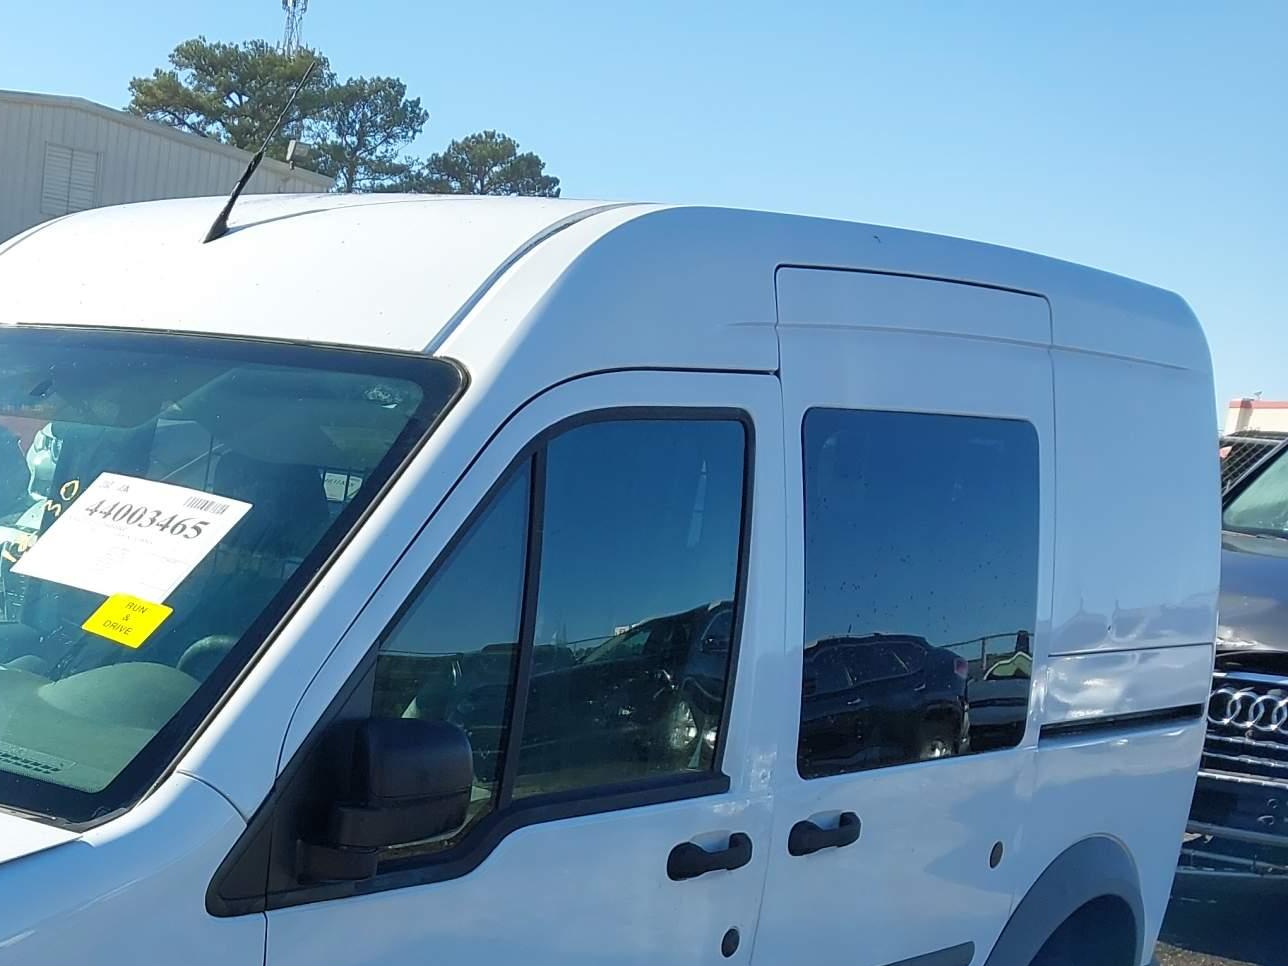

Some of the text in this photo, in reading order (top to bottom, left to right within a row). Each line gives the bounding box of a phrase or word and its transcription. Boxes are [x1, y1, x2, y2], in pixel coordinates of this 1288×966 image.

[85, 499, 211, 539] 44003465
[125, 601, 149, 614] RUN
[122, 613, 131, 622] &
[102, 619, 133, 636] DRIVE
